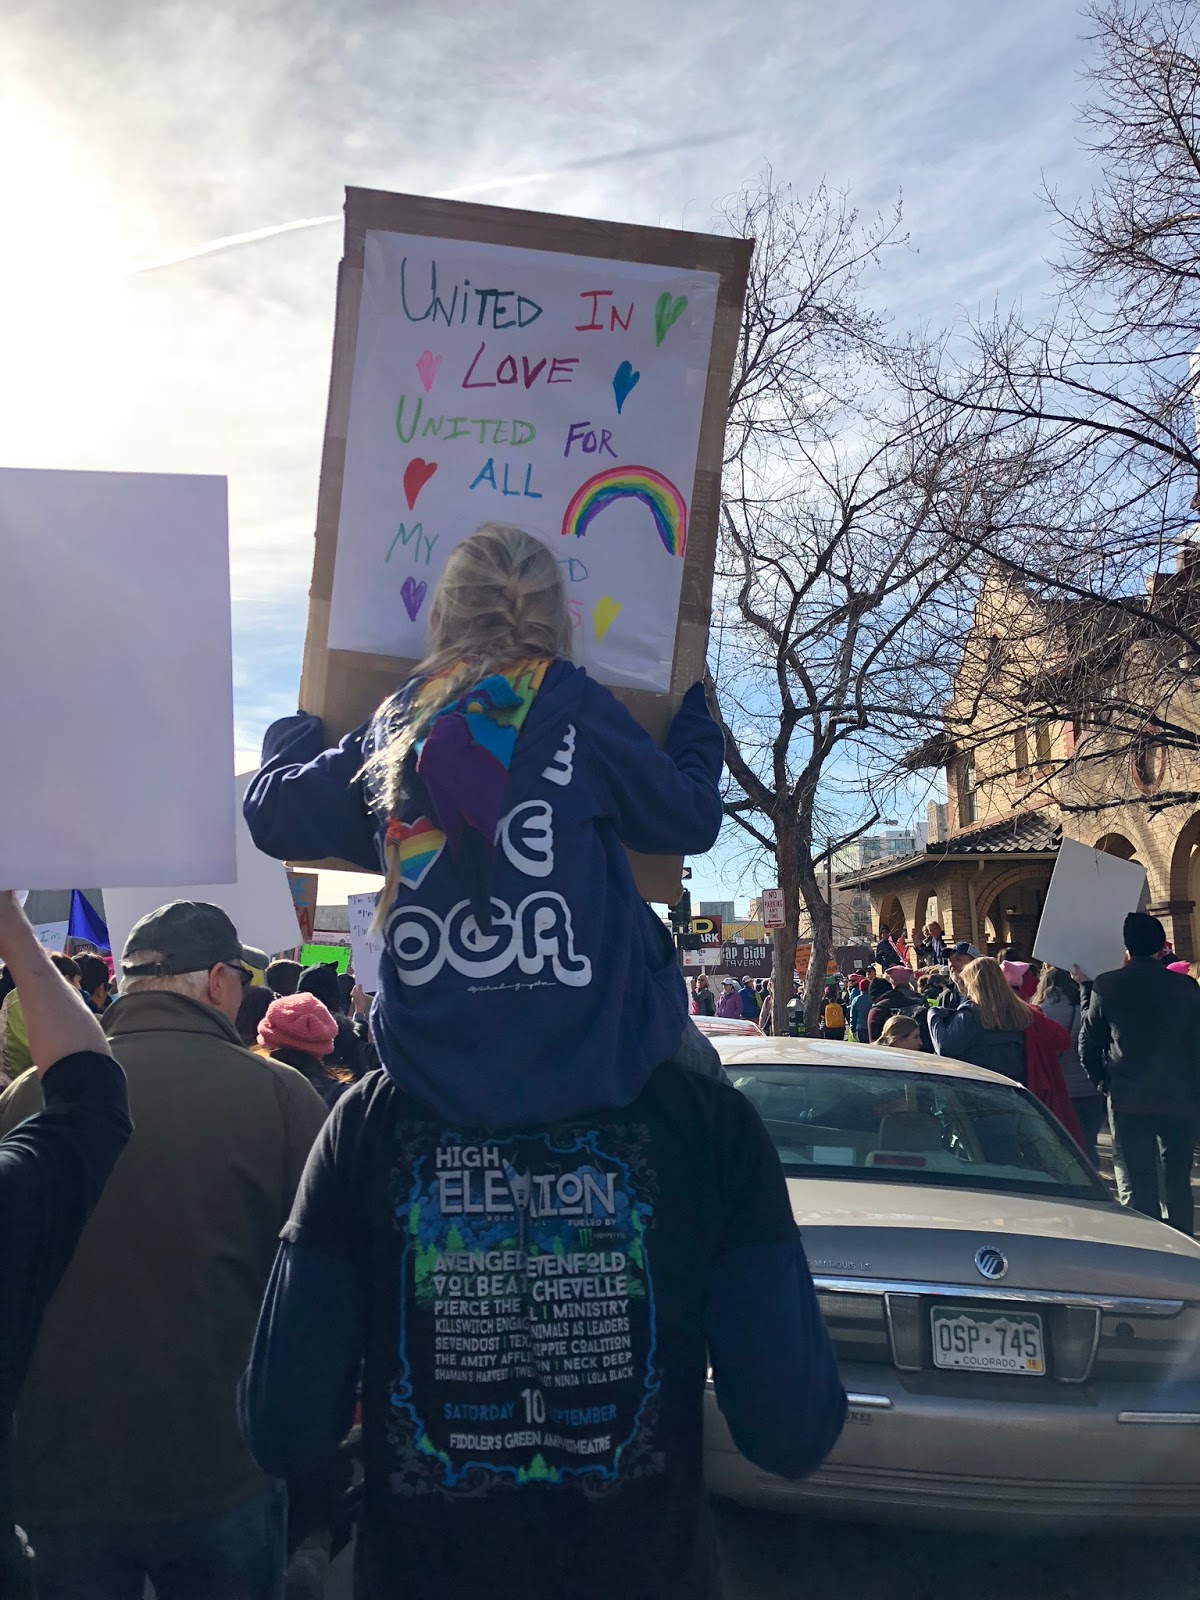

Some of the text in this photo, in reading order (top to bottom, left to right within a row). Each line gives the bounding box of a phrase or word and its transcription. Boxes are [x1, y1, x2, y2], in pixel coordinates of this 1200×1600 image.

[575, 290, 634, 332] IN
[462, 342, 580, 390] LOVE
[396, 395, 617, 458] UNITED FOR
[469, 457, 543, 498] ALL
[764, 900, 783, 908] PARKING
[768, 891, 777, 899] NO
[725, 959, 761, 967] TAVERN
[436, 1146, 500, 1168] HIGH
[568, 1218, 617, 1228] FUELED BY
[526, 1252, 627, 1278] EVENFOLD
[814, 1259, 856, 1270] MARQUIS
[860, 1262, 872, 1271] LS
[532, 1275, 628, 1303] CHEVELLE
[434, 1300, 490, 1316] PIERCE
[493, 1298, 521, 1314] THE
[553, 1299, 630, 1319] MINISTRY
[435, 1318, 494, 1334] KILLSWITCH
[530, 1316, 630, 1339] NIMALS AS LEADERS
[435, 1336, 500, 1352] SEVENDUST
[571, 1335, 631, 1354] COALITION
[434, 1353, 458, 1366] THE
[460, 1354, 498, 1368] AMITY
[563, 1351, 632, 1370] NECK DEEP
[963, 1356, 1017, 1368] COLORADO
[476, 1368, 509, 1383] HARVEST
[554, 1374, 580, 1387] NINJA
[587, 1367, 634, 1384] LOLA BLACK
[443, 1402, 516, 1421] SATURDAY
[521, 1388, 546, 1424] 10
[504, 1431, 542, 1449] GREEN
